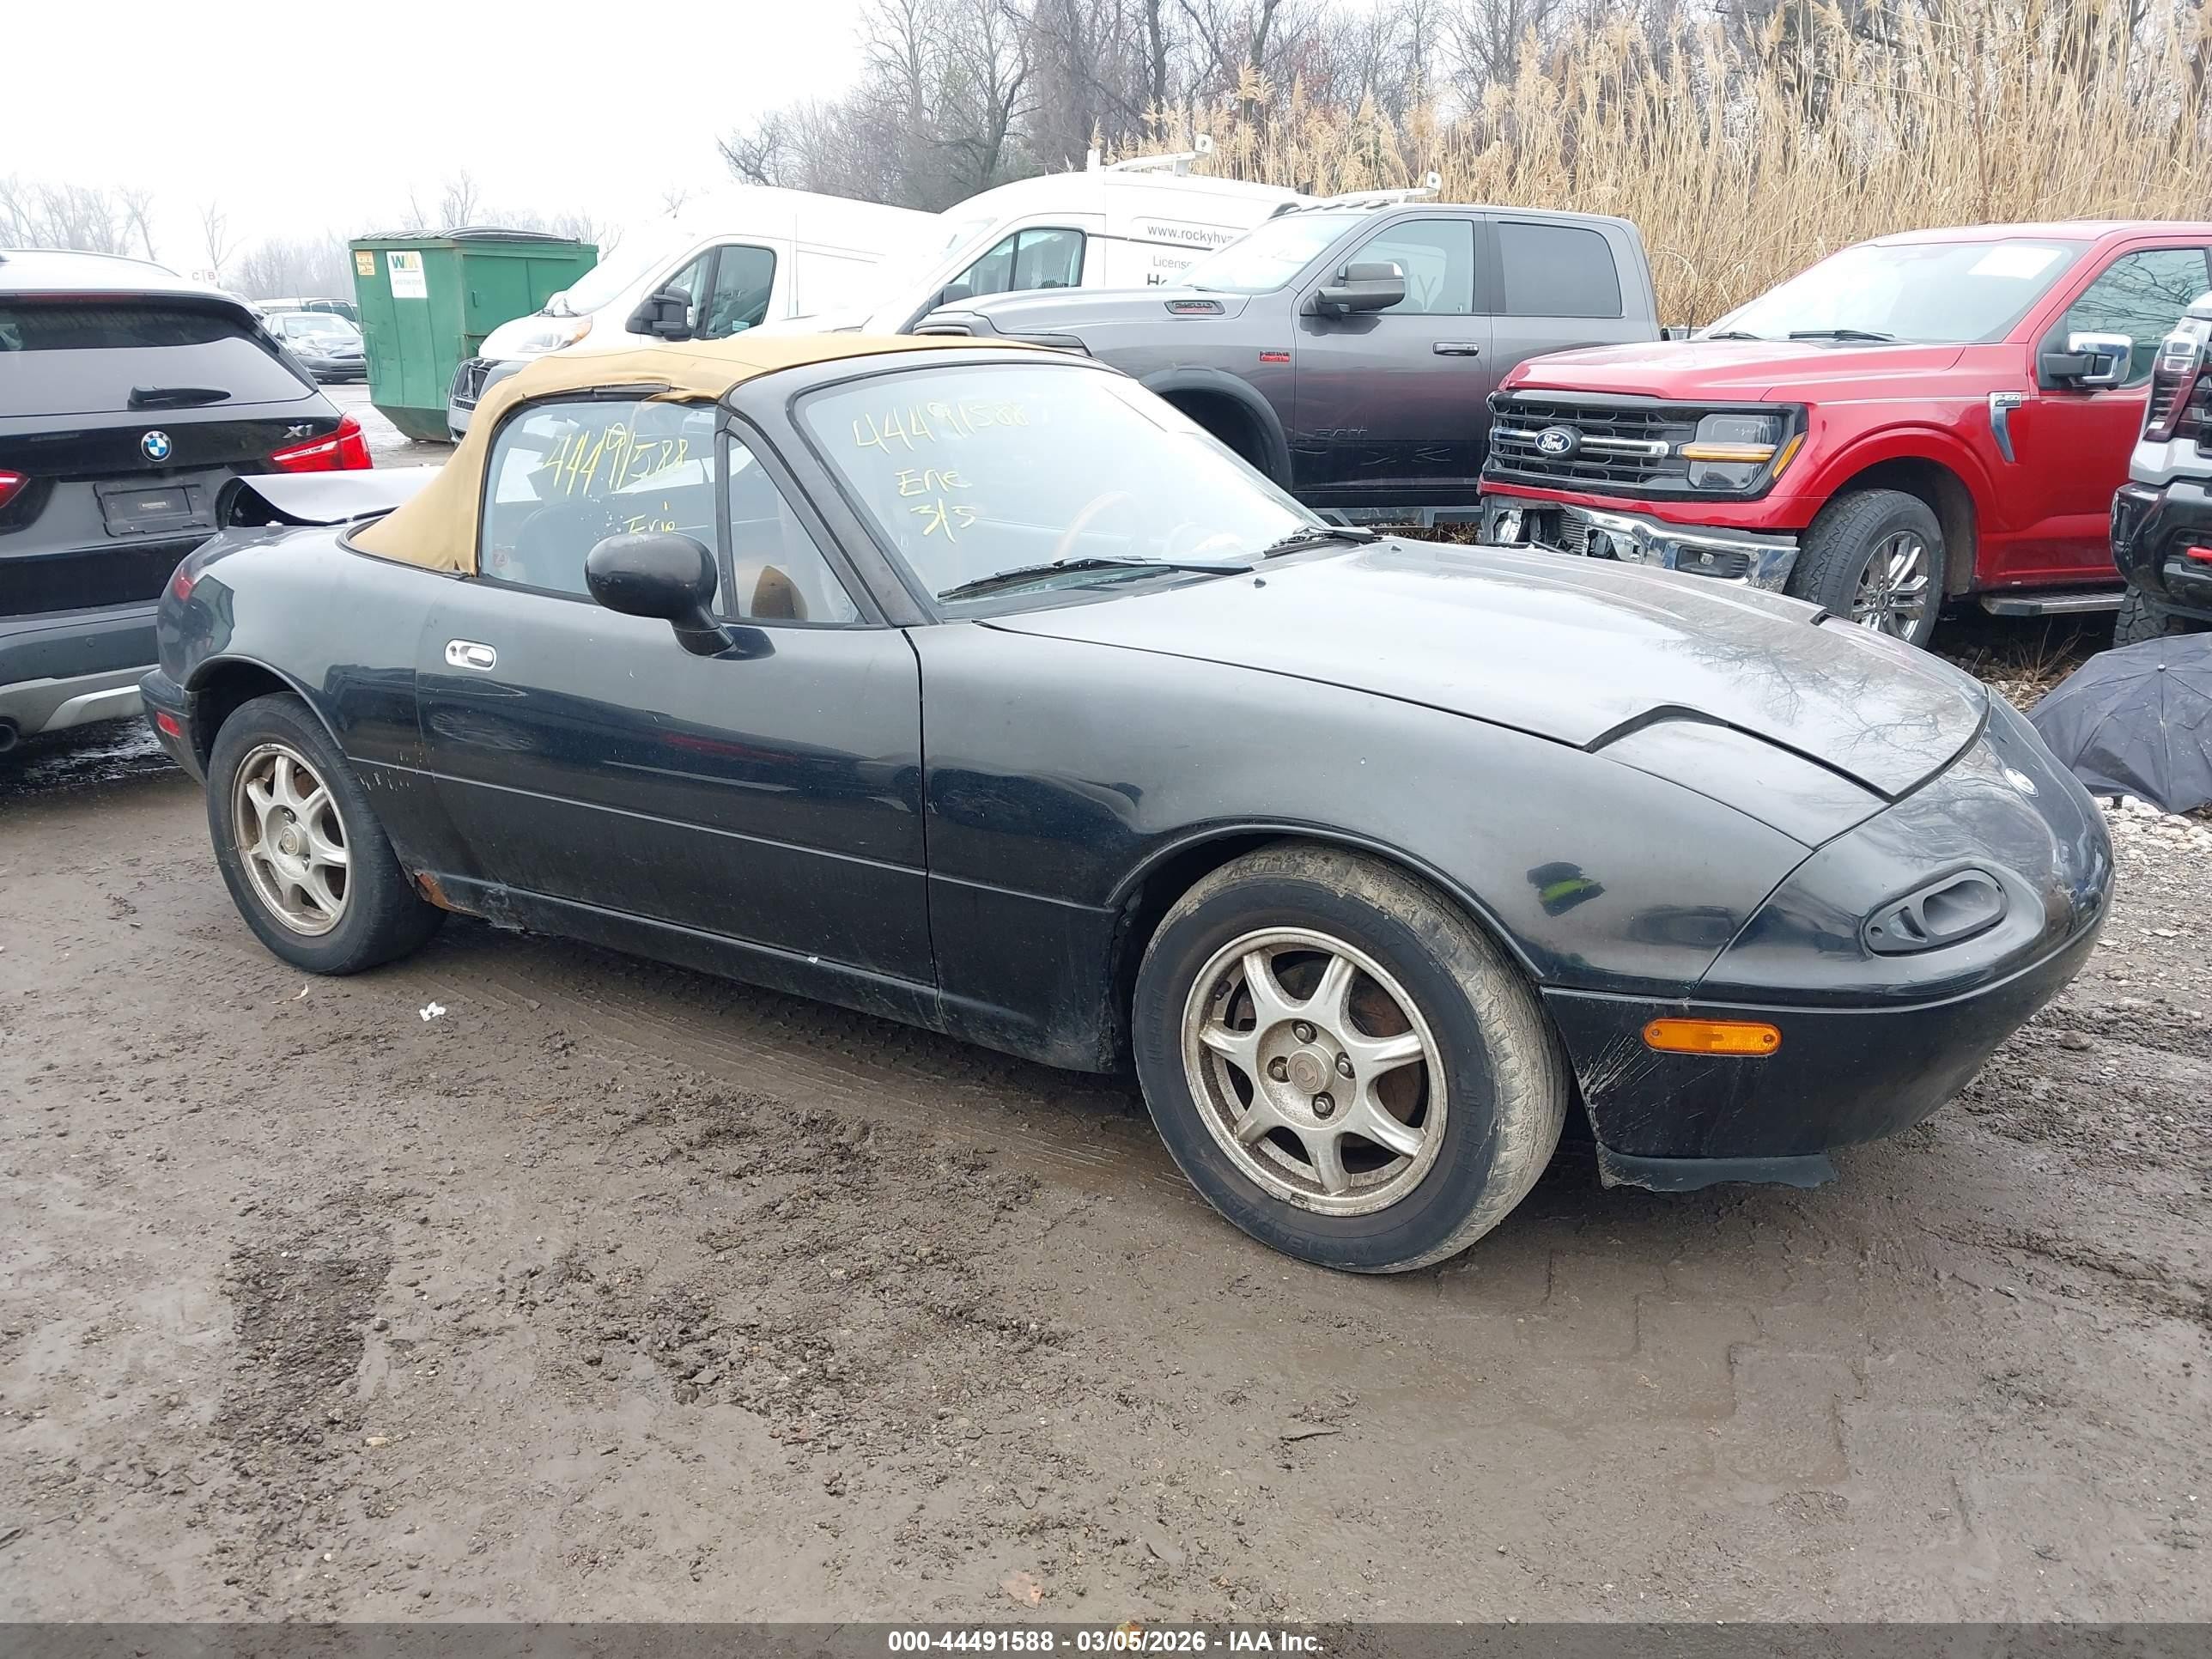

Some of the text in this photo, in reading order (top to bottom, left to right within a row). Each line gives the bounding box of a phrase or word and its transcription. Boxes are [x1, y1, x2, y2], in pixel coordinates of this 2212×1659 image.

[391, 253, 419, 269] WM
[191, 271, 199, 281] C
[207, 271, 216, 280] B
[283, 424, 313, 438] X1
[853, 402, 1030, 454] 44491588
[1541, 434, 1564, 450] Ford
[542, 422, 689, 495] 44491588
[909, 498, 975, 543] 3/5
